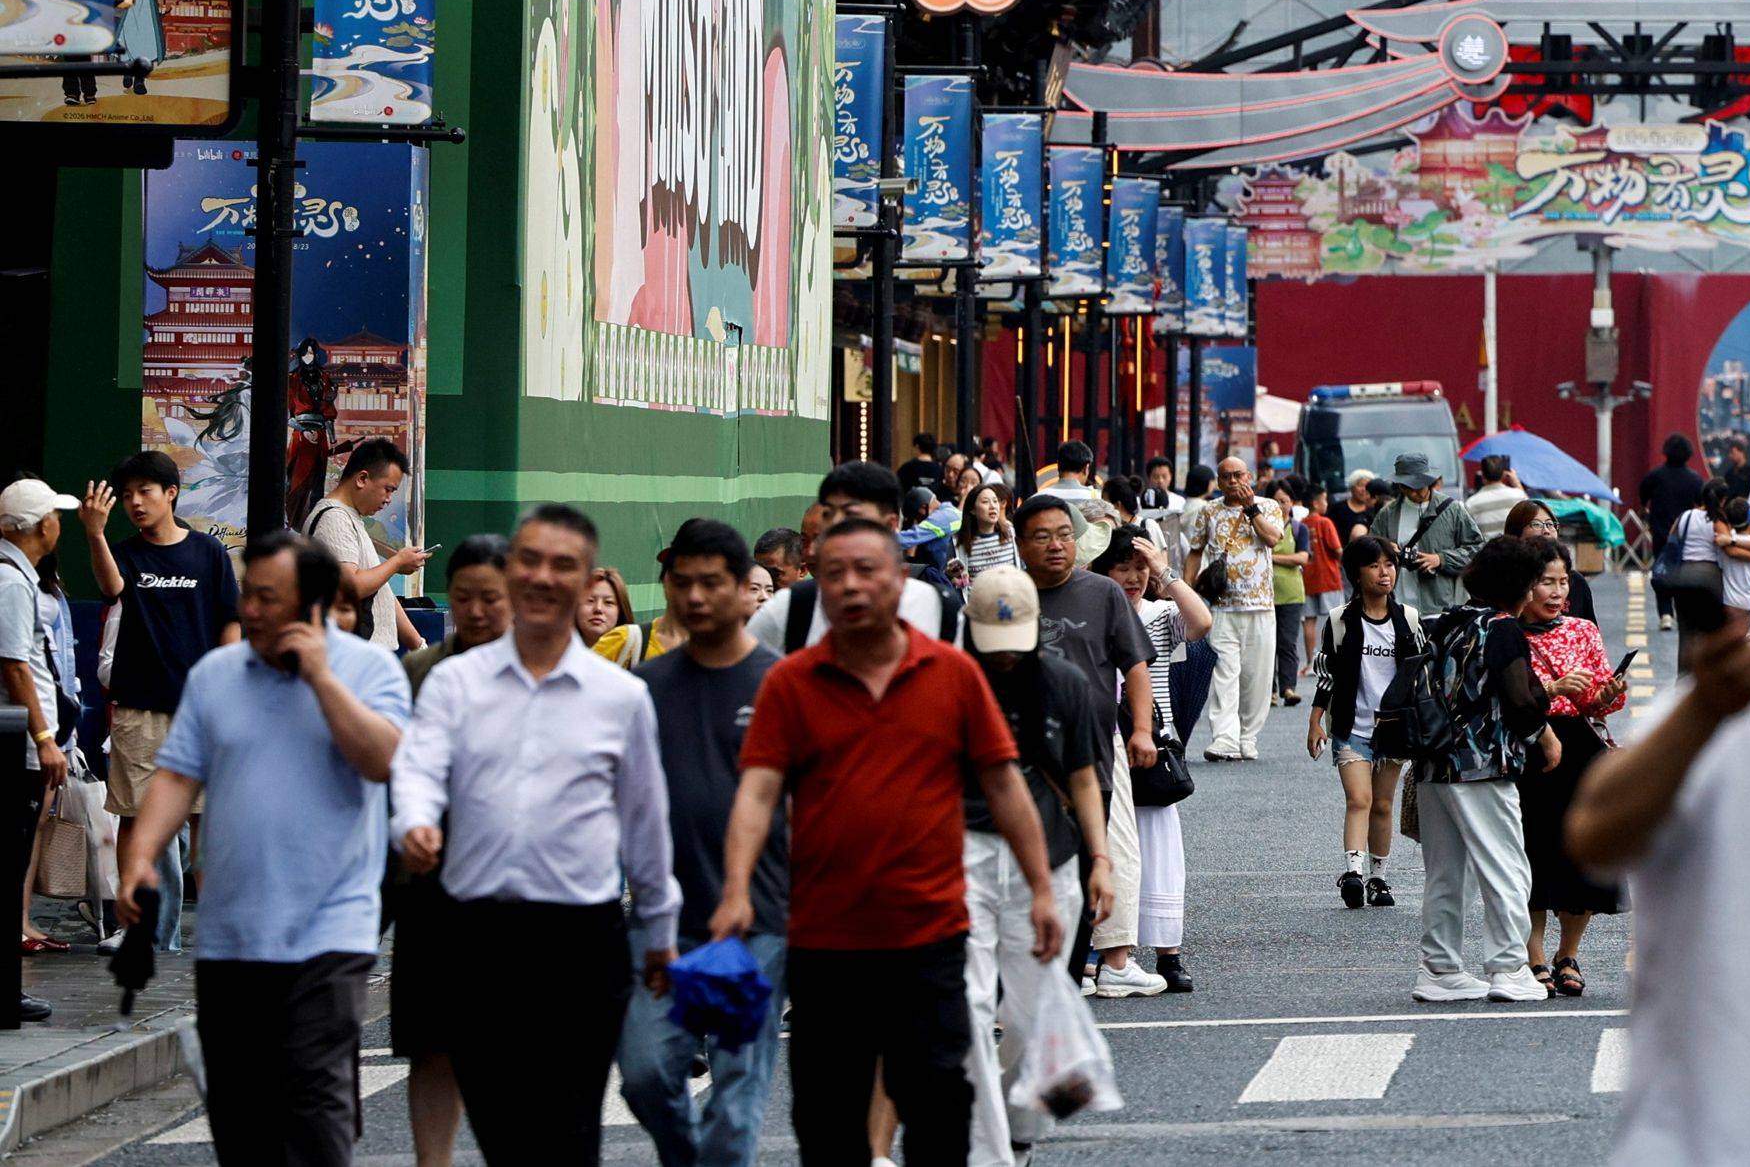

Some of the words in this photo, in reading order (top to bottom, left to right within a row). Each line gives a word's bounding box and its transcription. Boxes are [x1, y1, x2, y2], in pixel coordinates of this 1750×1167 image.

[916, 115, 952, 205] 万物有灵
[993, 150, 1026, 230] 万物有灵
[197, 197, 343, 238] 万灵
[136, 572, 198, 588] Dickies
[1361, 645, 1397, 657] didas
